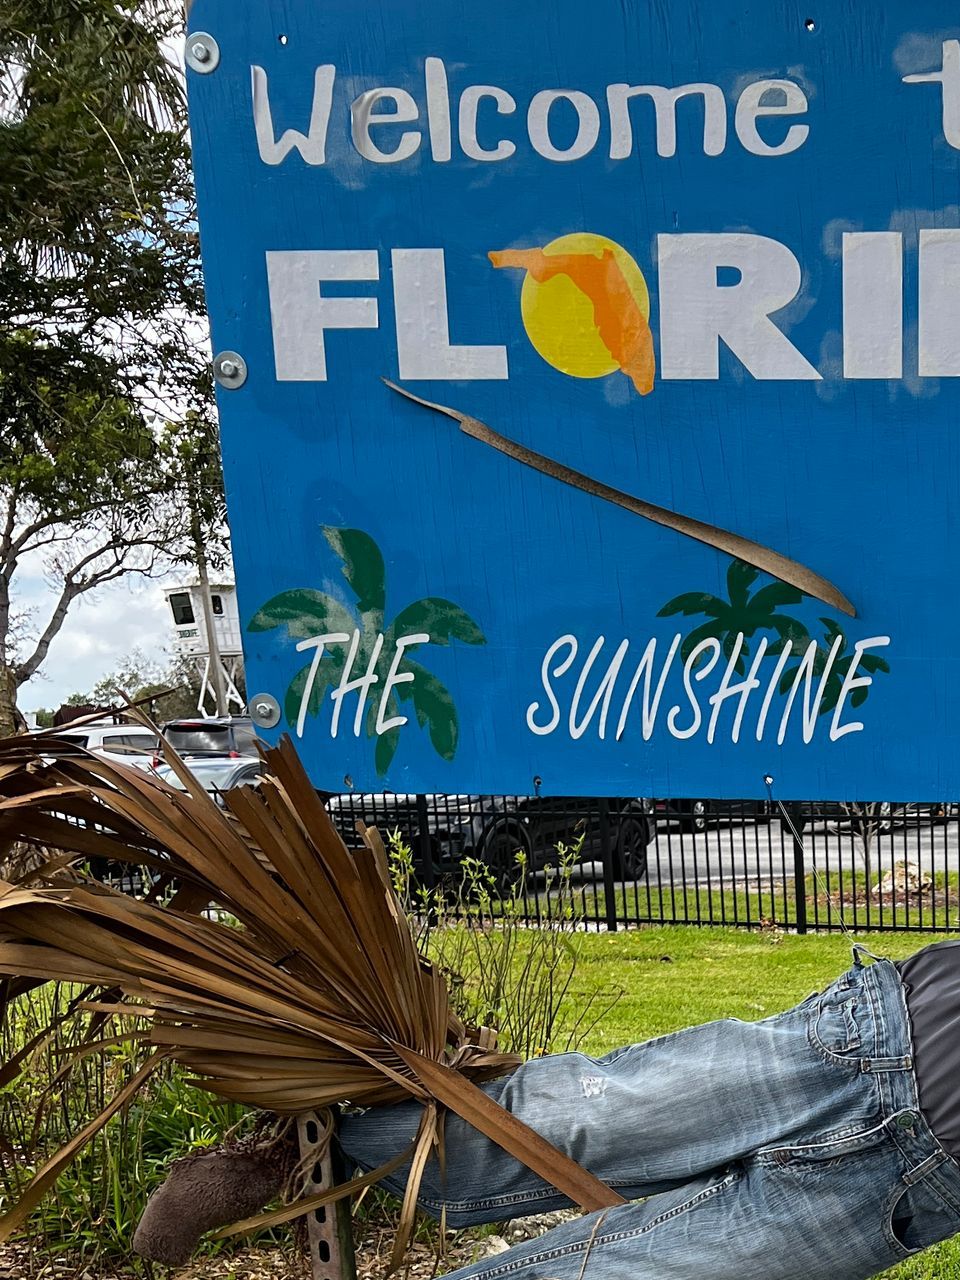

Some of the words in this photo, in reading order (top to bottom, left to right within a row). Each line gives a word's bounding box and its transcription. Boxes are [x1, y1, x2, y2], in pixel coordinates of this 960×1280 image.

[250, 57, 810, 166] Welcome
[295, 625, 430, 739] THE
[526, 632, 891, 745] SUNSHINE
